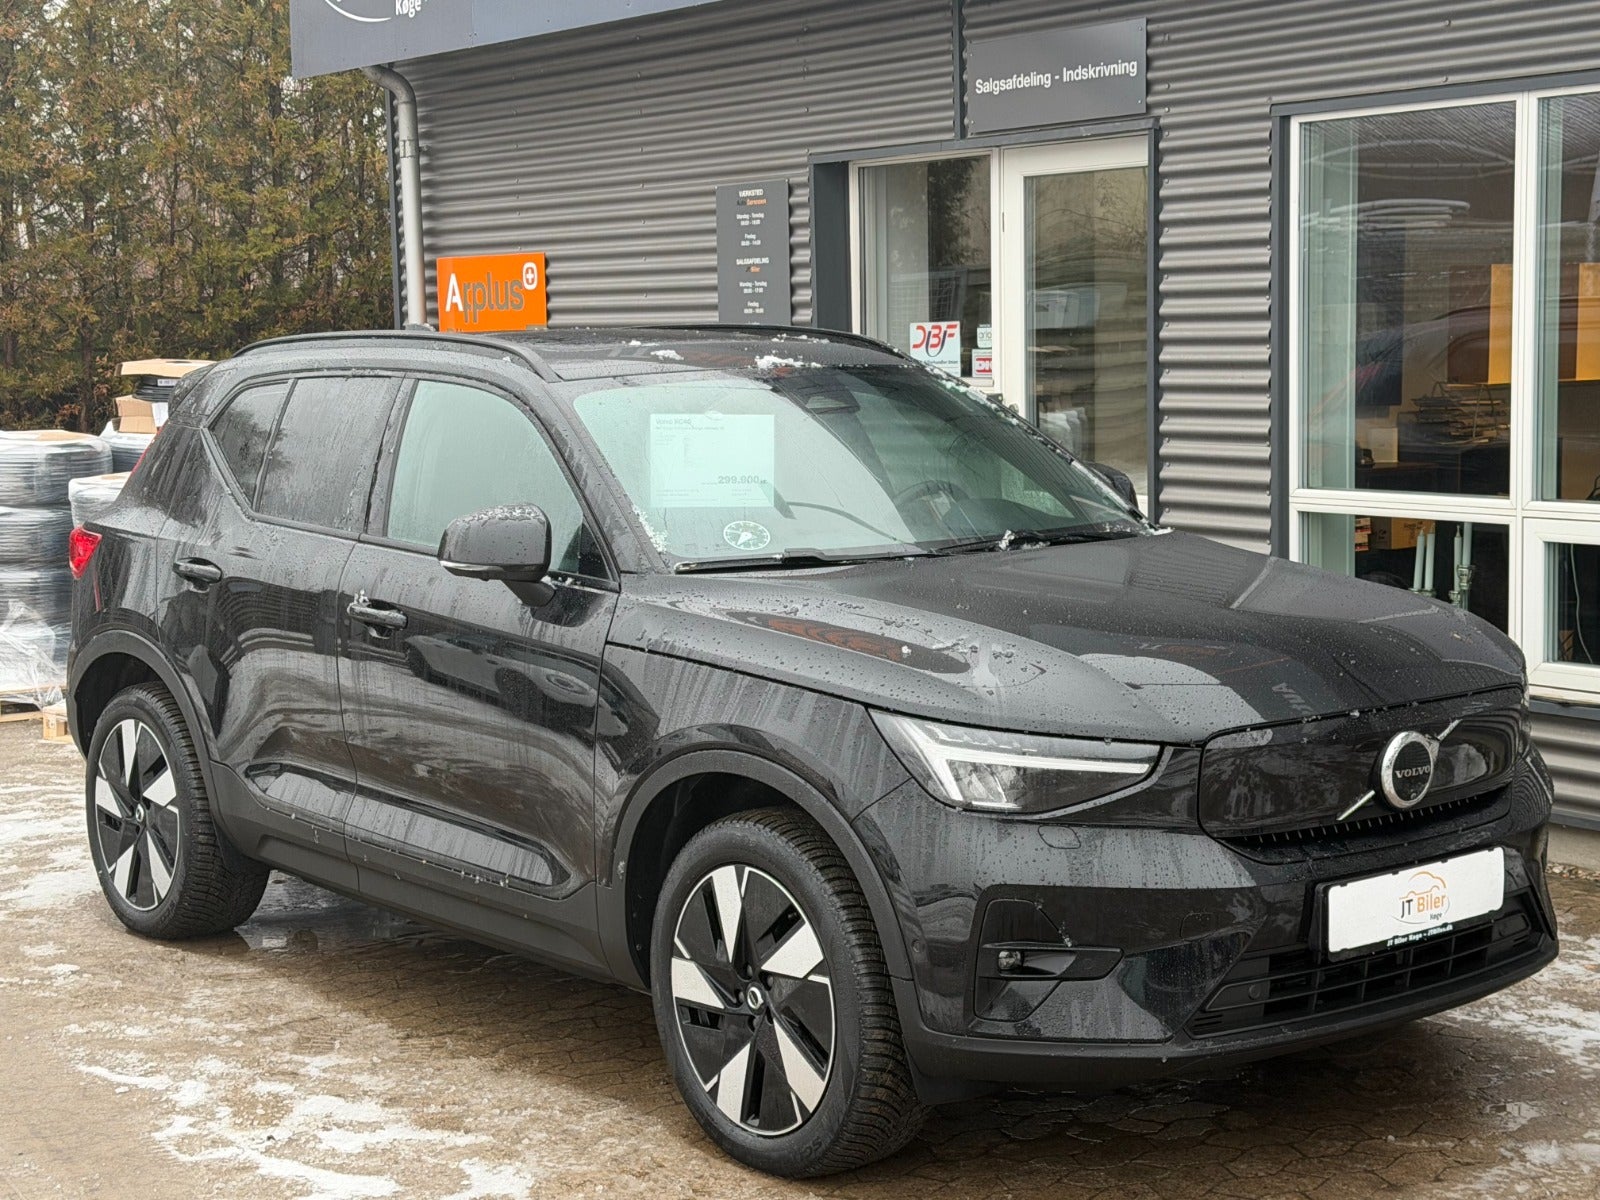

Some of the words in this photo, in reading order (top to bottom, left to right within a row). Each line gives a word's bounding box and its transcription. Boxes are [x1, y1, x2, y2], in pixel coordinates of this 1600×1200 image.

[395, 0, 421, 18] Køge
[975, 71, 1051, 95] Salgsafdeling
[1063, 59, 1138, 82] Indskrivning
[1394, 765, 1431, 779] VOLVO
[1400, 899, 1414, 919] JT
[1417, 893, 1446, 913] Biler
